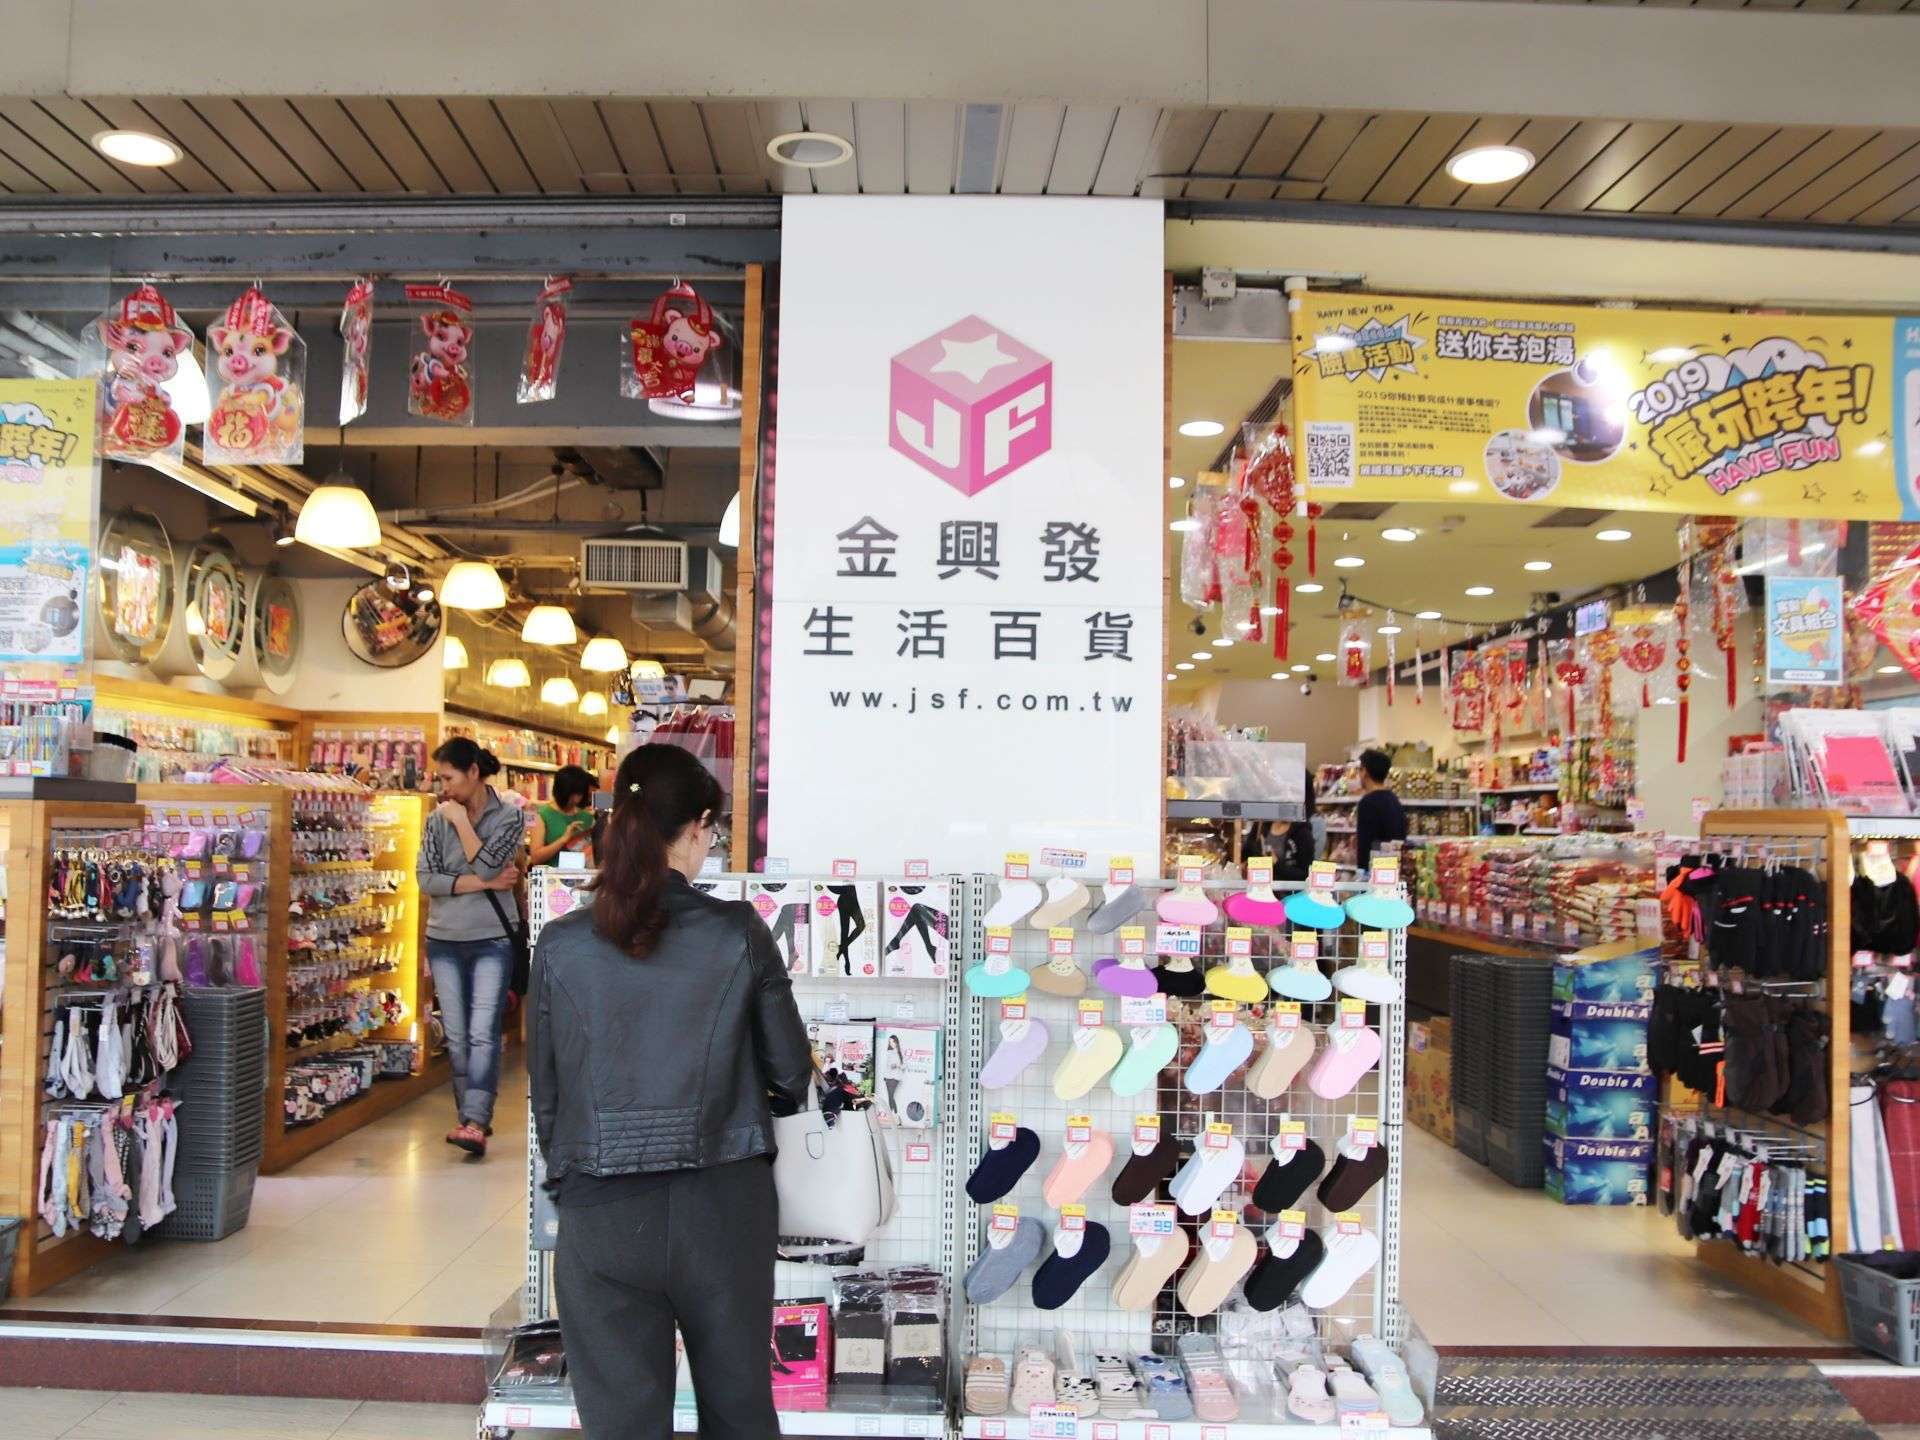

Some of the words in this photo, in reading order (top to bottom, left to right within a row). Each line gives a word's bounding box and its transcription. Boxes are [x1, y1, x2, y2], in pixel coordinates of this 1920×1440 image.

[1348, 306, 1369, 317] NEW
[1374, 304, 1394, 313] YEAR
[1437, 328, 1576, 366] 送你去泡湯
[1628, 359, 1710, 425] 2019
[215, 409, 252, 449] 福
[1705, 448, 1780, 496] HAVE
[1781, 436, 1840, 467] FUN
[835, 515, 1101, 583] 金興發
[803, 606, 1133, 662] 生活百貨
[1176, 939, 1198, 953] 100
[1586, 1005, 1635, 1018] Double
[1638, 1007, 1649, 1019] A
[1580, 1075, 1628, 1088] Double
[1632, 1077, 1644, 1088] A
[1577, 1144, 1626, 1157] Double
[1630, 1146, 1641, 1157] A
[1153, 1220, 1173, 1233] 99
[1055, 1421, 1076, 1436] 99
